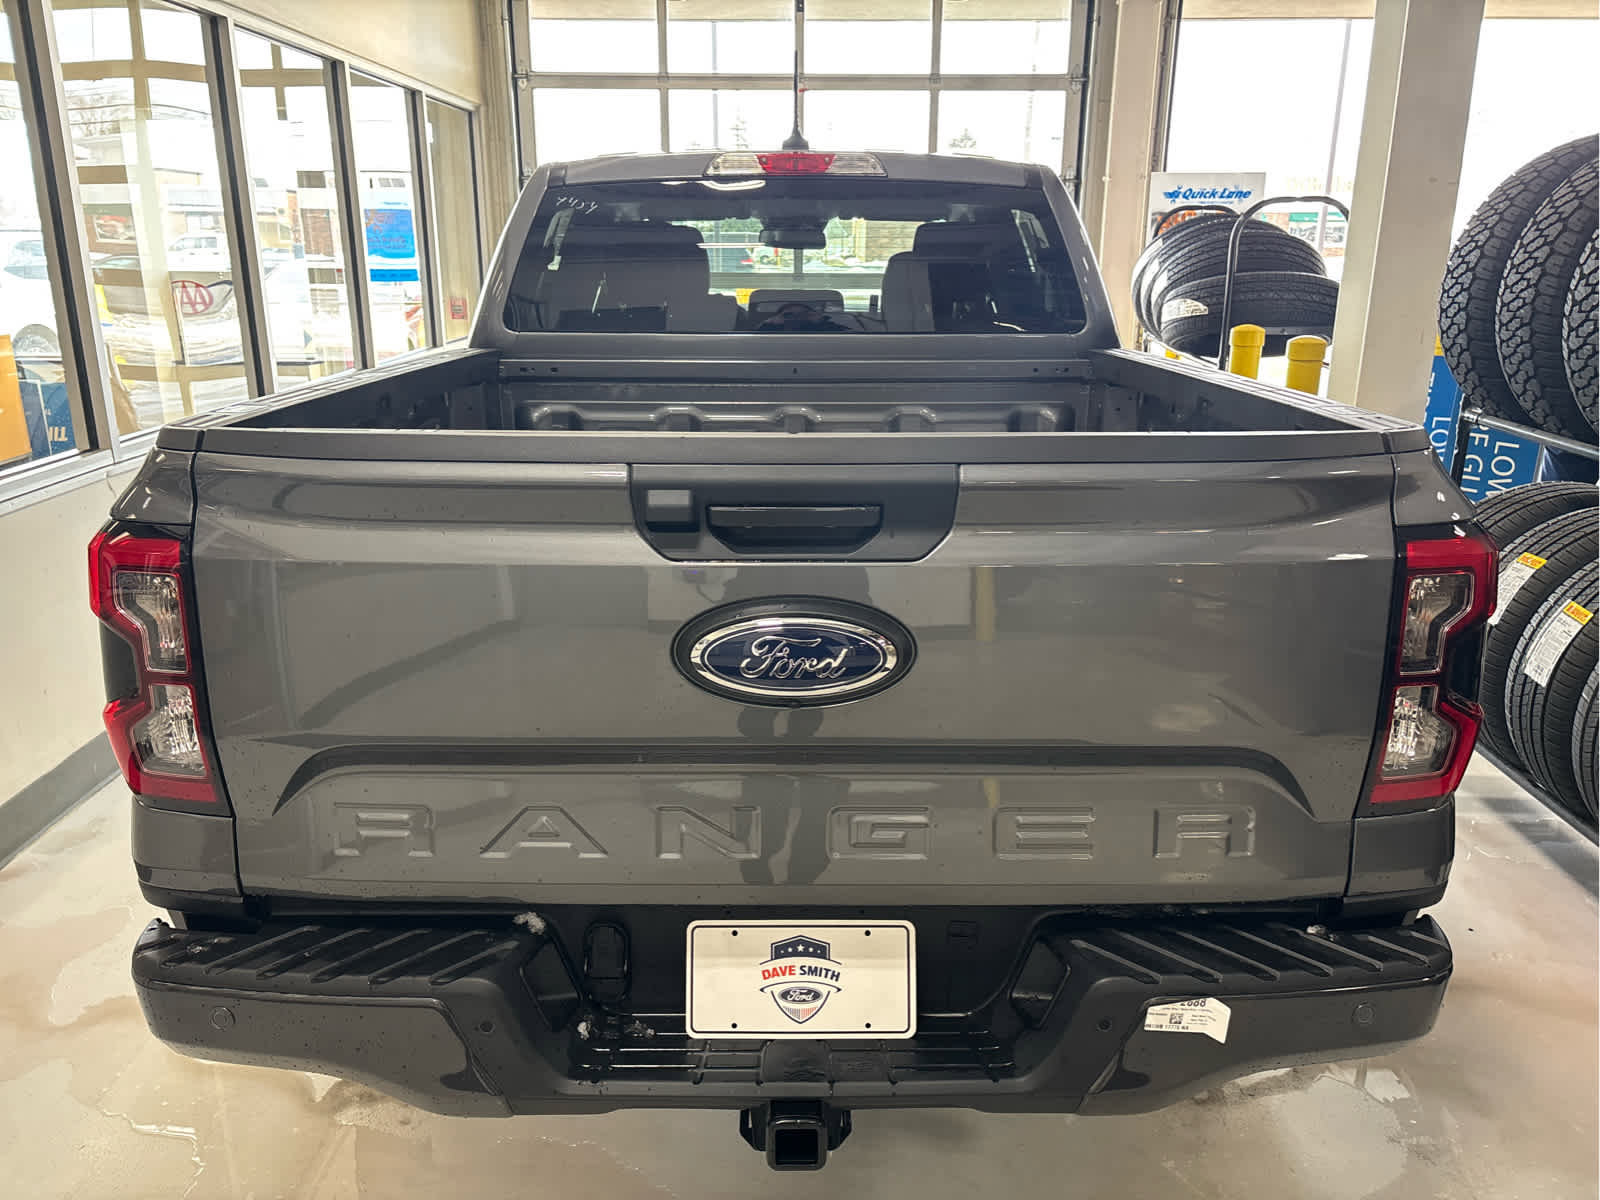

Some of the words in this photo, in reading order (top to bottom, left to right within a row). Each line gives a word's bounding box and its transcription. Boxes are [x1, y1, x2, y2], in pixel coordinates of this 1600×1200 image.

[1182, 188, 1218, 199] Quick
[1219, 188, 1252, 199] Lane
[739, 634, 850, 679] Ford
[333, 800, 1257, 861] RANGER
[761, 965, 796, 980] DAVE
[799, 965, 841, 982] SMITH
[786, 989, 815, 1001] Ford
